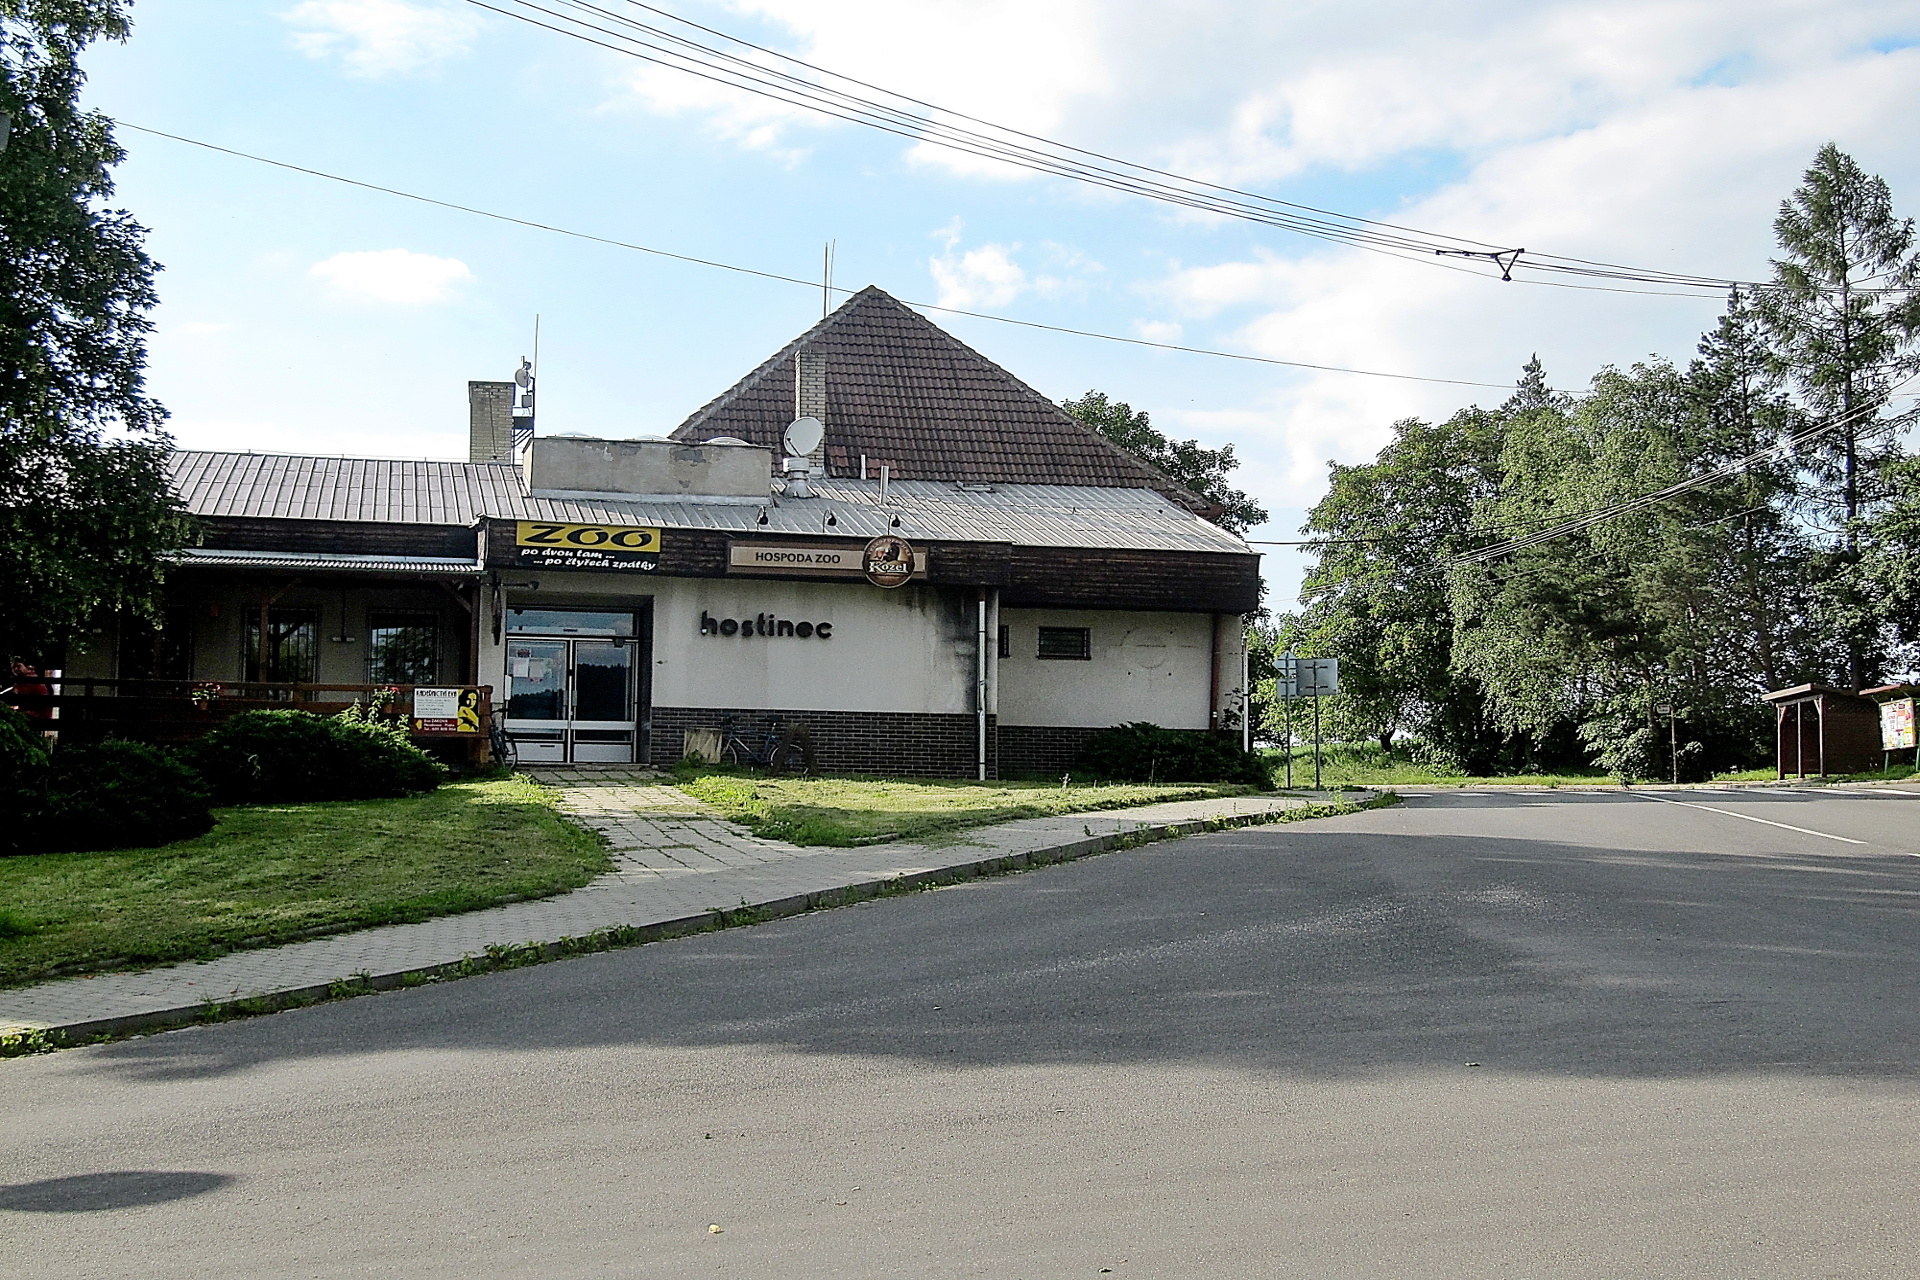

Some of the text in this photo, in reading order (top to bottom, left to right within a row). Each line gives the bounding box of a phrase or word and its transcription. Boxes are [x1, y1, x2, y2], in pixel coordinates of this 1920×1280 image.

[524, 525, 653, 548] ZOO
[521, 548, 538, 557] po
[541, 548, 574, 557] dvou
[576, 548, 602, 559] tam
[755, 552, 841, 564] HOSPODA ZOO
[545, 558, 562, 566] po
[565, 558, 609, 568] čtyřech
[612, 560, 656, 570] zpátky
[869, 561, 909, 574] Kozel
[701, 610, 833, 638] hostinec
